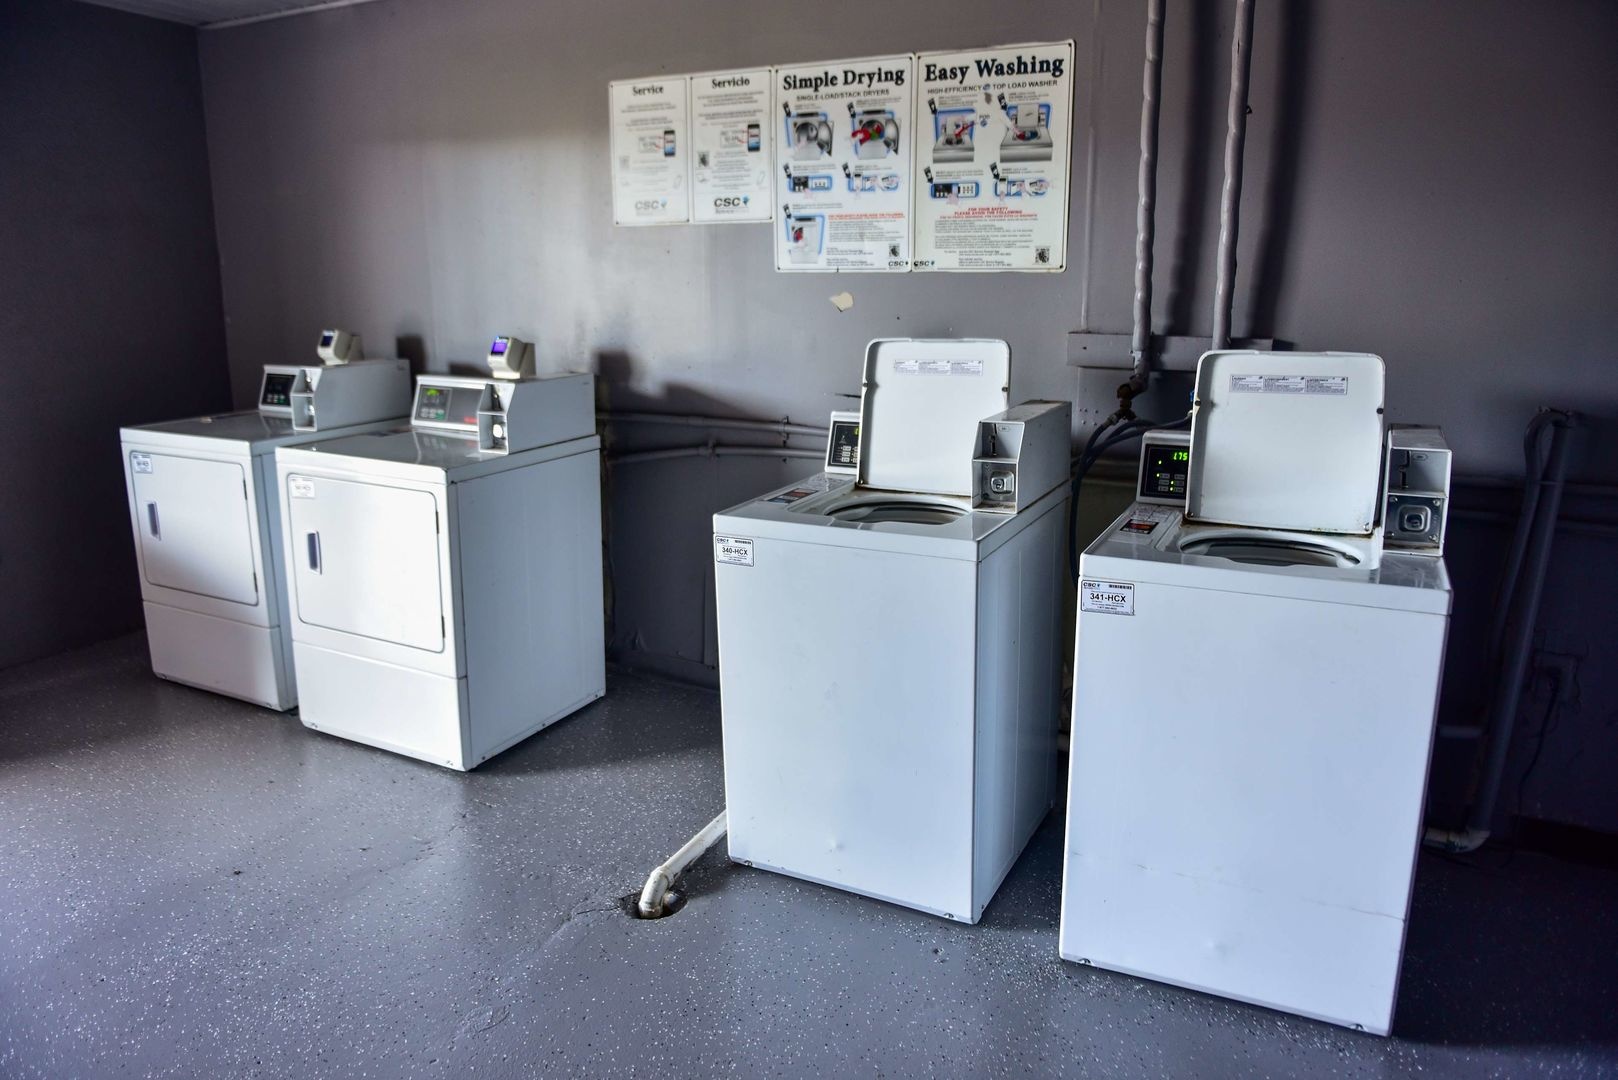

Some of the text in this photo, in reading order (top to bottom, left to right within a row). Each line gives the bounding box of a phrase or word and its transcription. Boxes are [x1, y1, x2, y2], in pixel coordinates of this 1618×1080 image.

[924, 56, 1064, 84] Easy Washing
[711, 76, 750, 89] Servicio
[783, 67, 905, 92] Simple Drying
[1028, 80, 1058, 88] WASHER
[632, 85, 664, 96] Service
[863, 89, 890, 97] DRYERS
[635, 200, 659, 210] CSC
[714, 197, 741, 208] CSC
[722, 546, 748, 555] 340-HCX
[1090, 592, 1126, 602] 341-HCX
